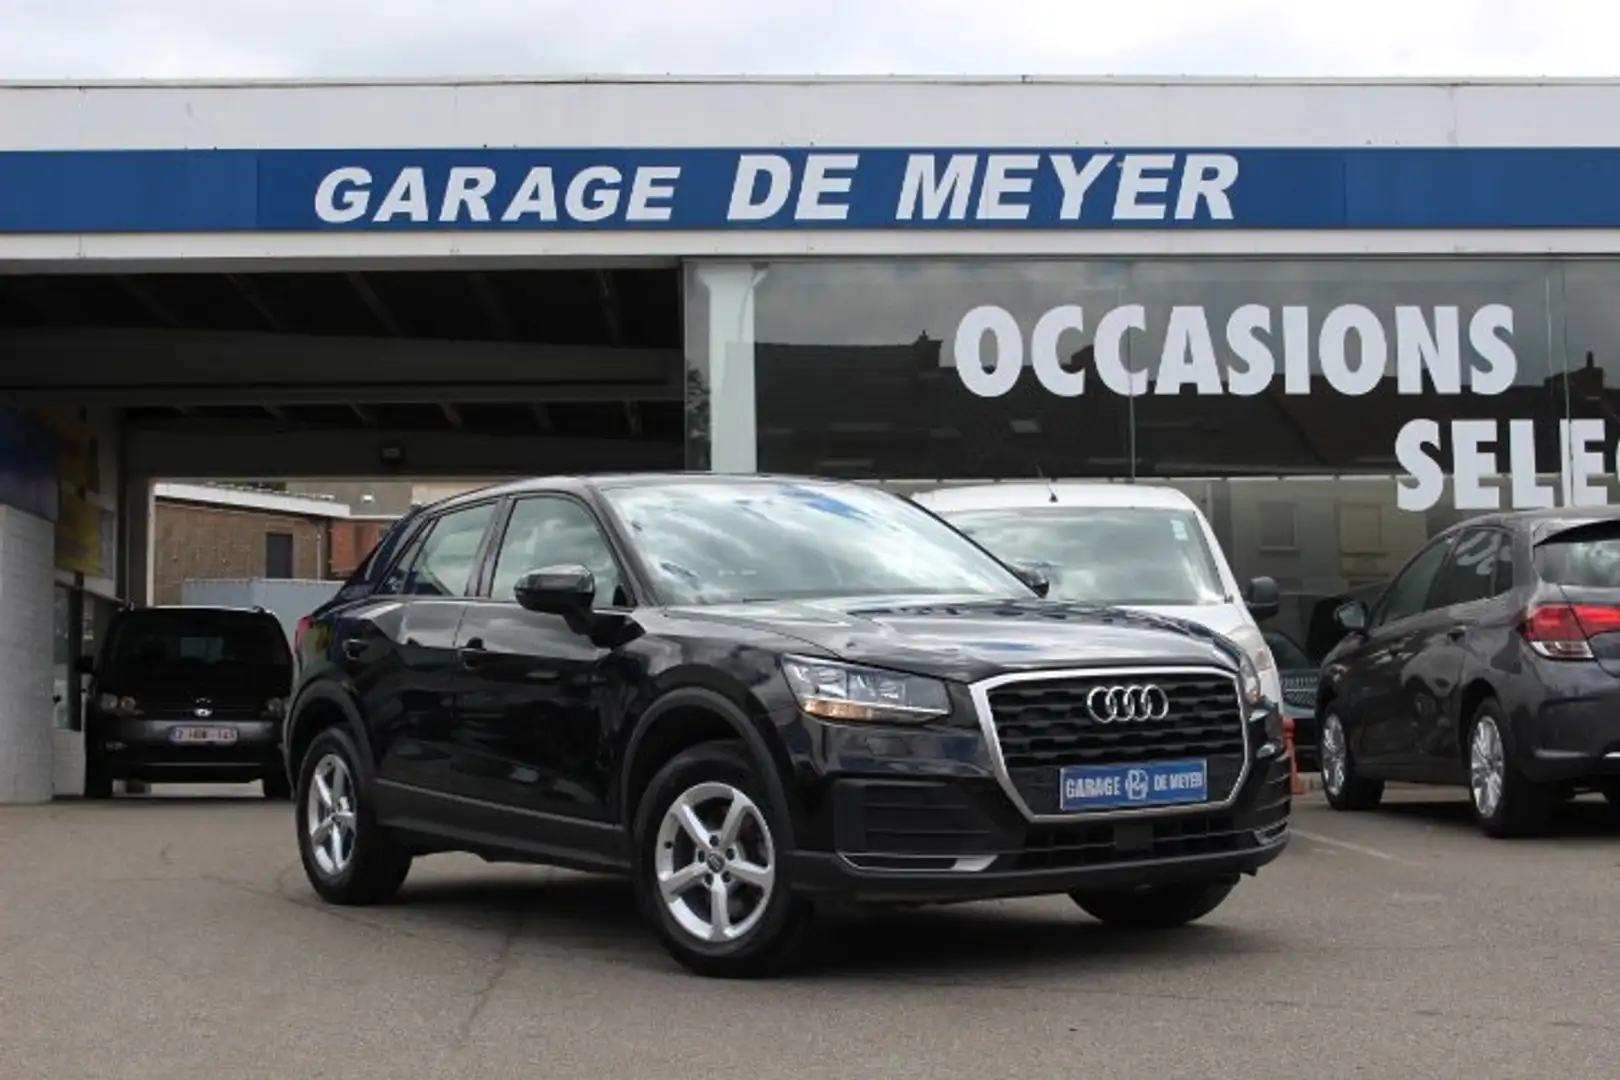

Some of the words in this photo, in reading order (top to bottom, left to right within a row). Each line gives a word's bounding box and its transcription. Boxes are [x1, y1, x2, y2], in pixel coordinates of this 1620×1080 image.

[314, 166, 682, 223] GARAGE
[727, 154, 860, 221] DE
[895, 153, 1240, 221] MEYER
[954, 303, 1518, 397] OCCASIONS
[1395, 418, 1620, 512] SELE
[1065, 776, 1121, 799] GARAGE
[1153, 773, 1168, 791] DE
[1169, 771, 1204, 790] MEYER
